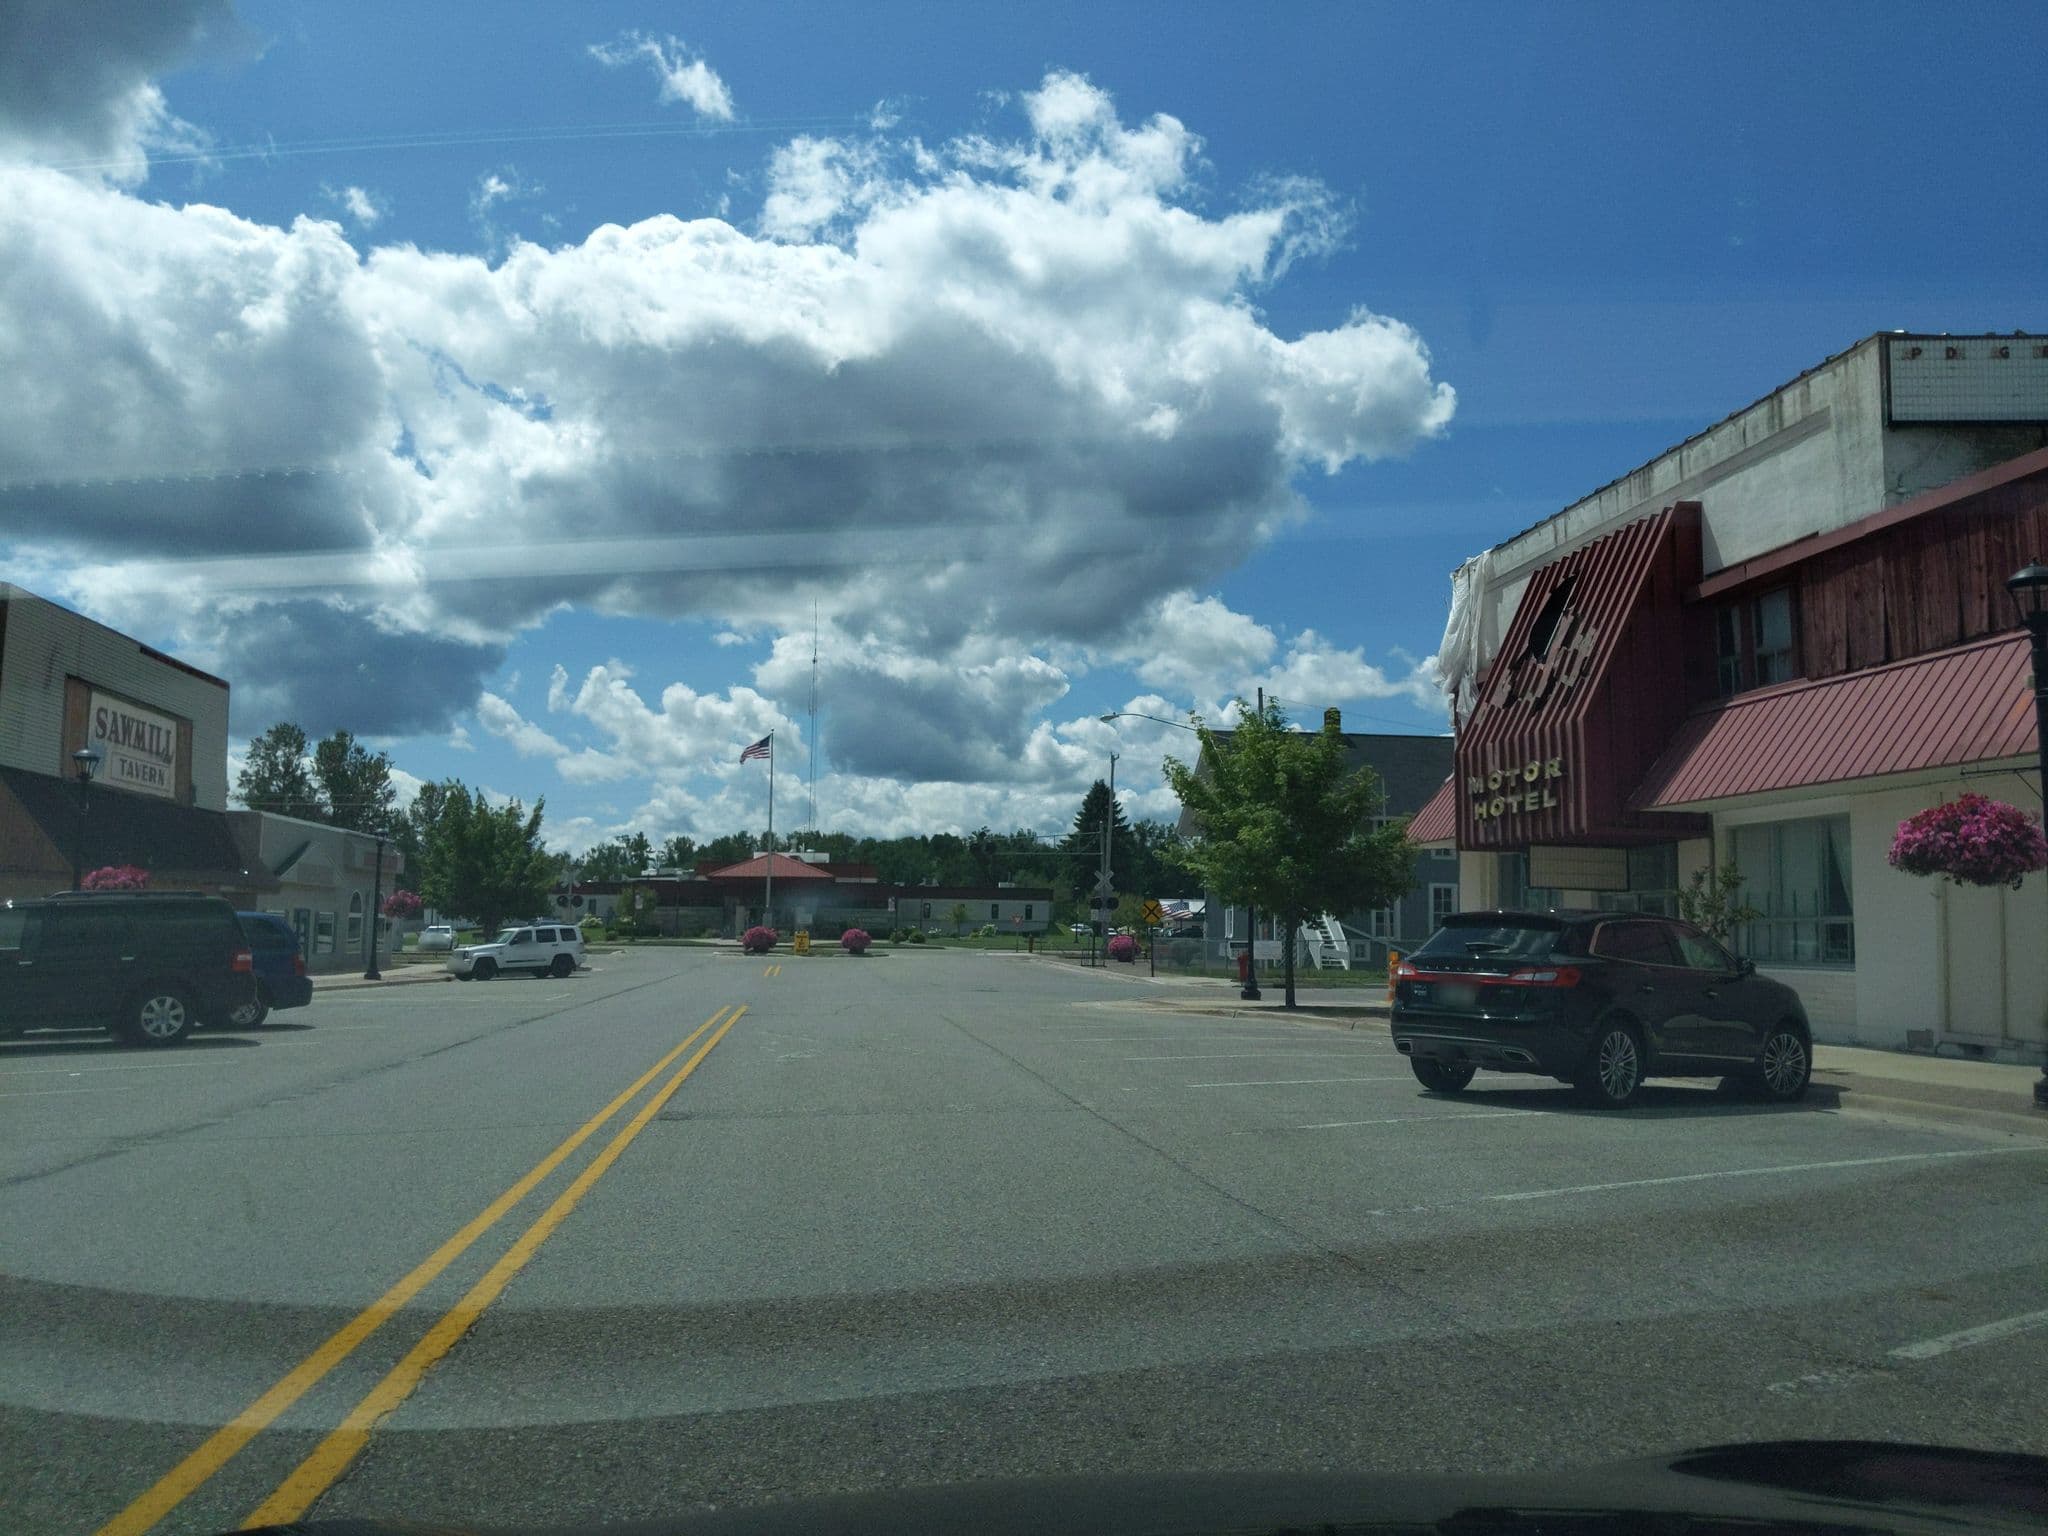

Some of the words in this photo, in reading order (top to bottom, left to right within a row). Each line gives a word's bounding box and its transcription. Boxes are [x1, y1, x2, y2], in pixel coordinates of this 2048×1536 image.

[95, 706, 174, 764] SAWMILL
[119, 757, 166, 786] TAVERN
[1467, 756, 1562, 795] MOTOR
[1474, 788, 1558, 820] HOTEL
